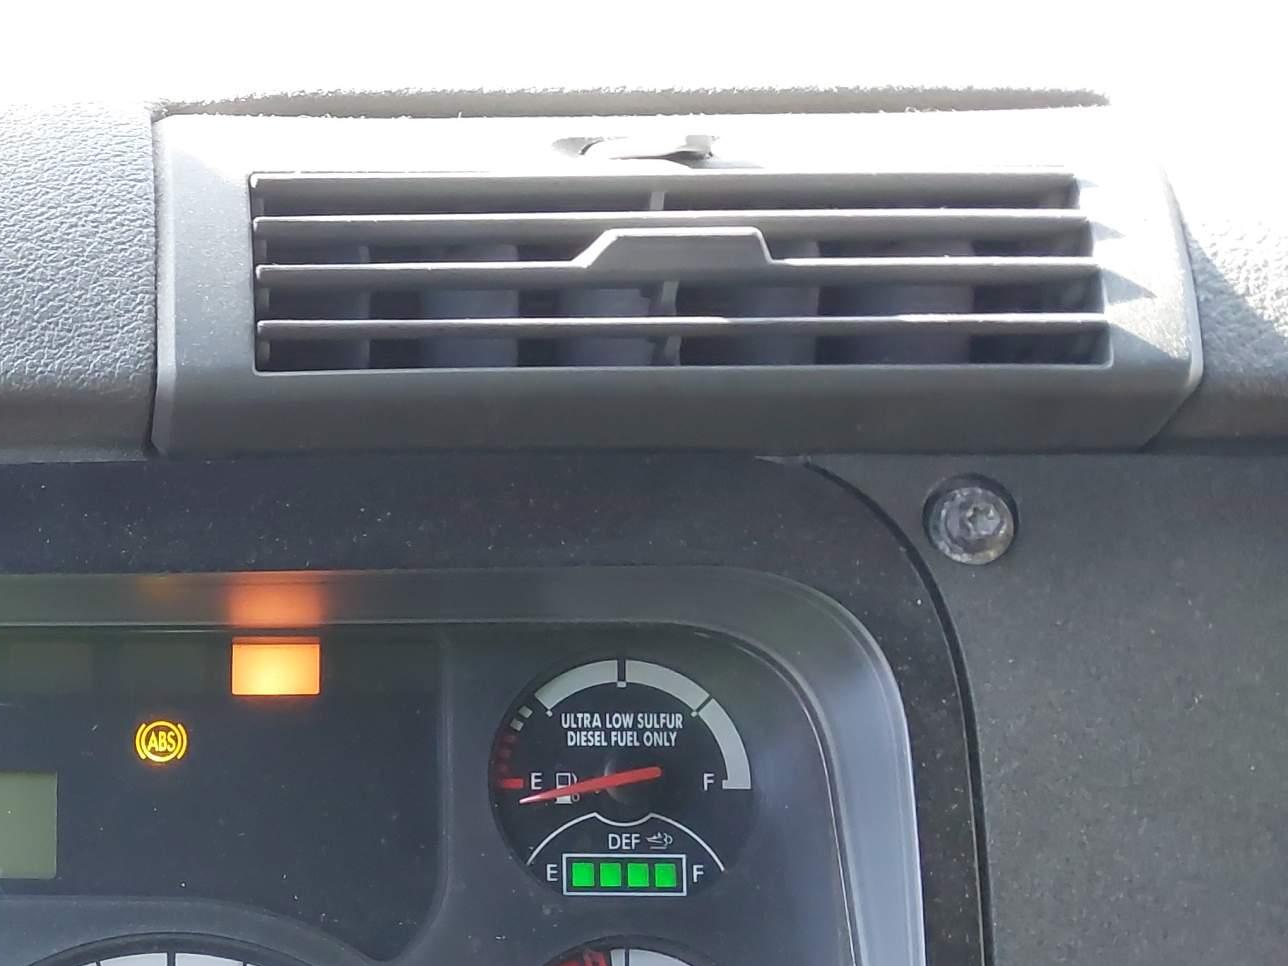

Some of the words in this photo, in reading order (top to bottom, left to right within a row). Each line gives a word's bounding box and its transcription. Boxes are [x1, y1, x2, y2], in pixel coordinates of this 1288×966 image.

[561, 713, 602, 729] ULTRA
[605, 713, 634, 729] LOW
[637, 713, 683, 729] SULFUR
[147, 731, 176, 752] ABS
[567, 731, 607, 747] DIESEL
[610, 731, 639, 747] FUEL
[643, 731, 678, 747] ONLY
[530, 772, 543, 791] E
[703, 773, 715, 791] F
[608, 833, 641, 850] DEF
[546, 864, 558, 882] E
[692, 864, 704, 882] F
